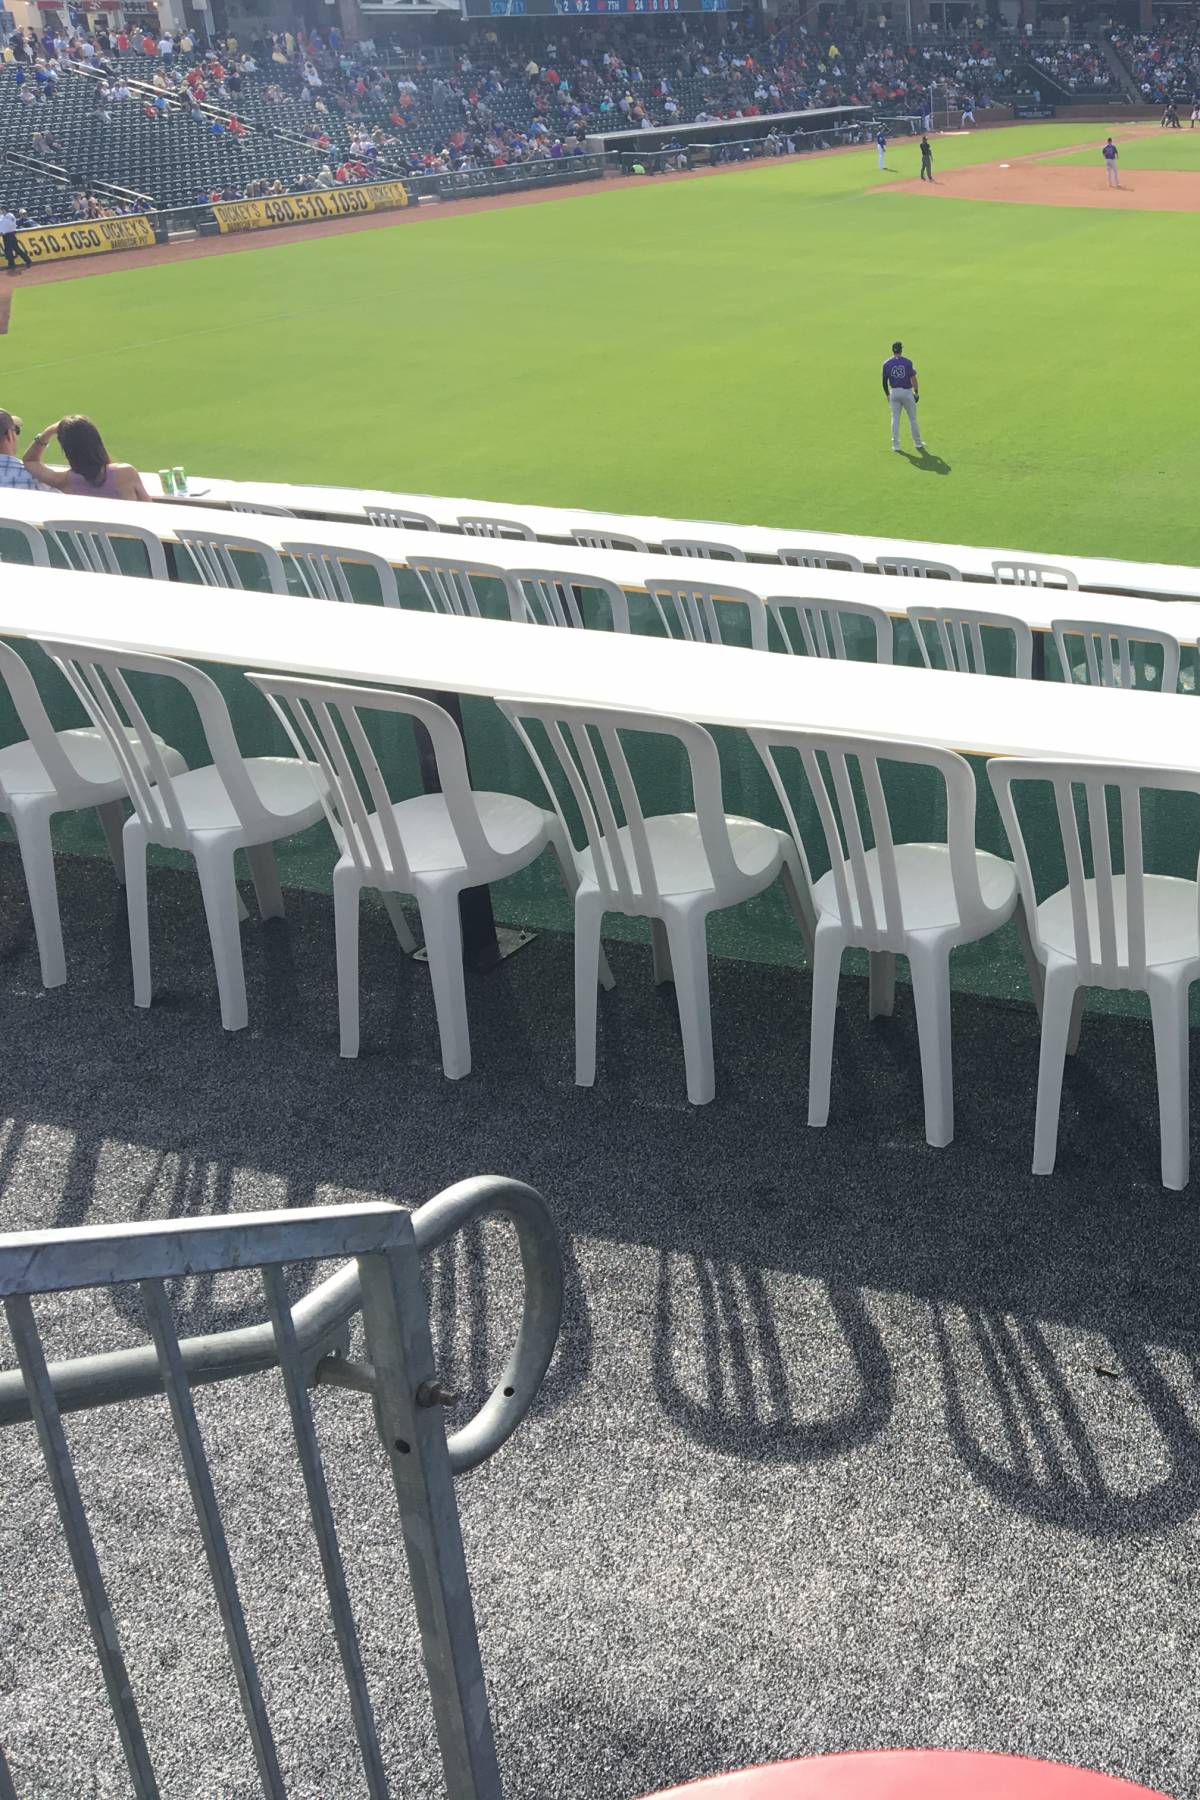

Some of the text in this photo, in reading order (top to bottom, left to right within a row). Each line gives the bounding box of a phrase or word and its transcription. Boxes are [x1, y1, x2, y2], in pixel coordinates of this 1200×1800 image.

[217, 203, 261, 223] DICKEY'S
[265, 190, 368, 223] 480.510.1050
[100, 218, 149, 240] DICKEY'S
[891, 364, 905, 378] 43
